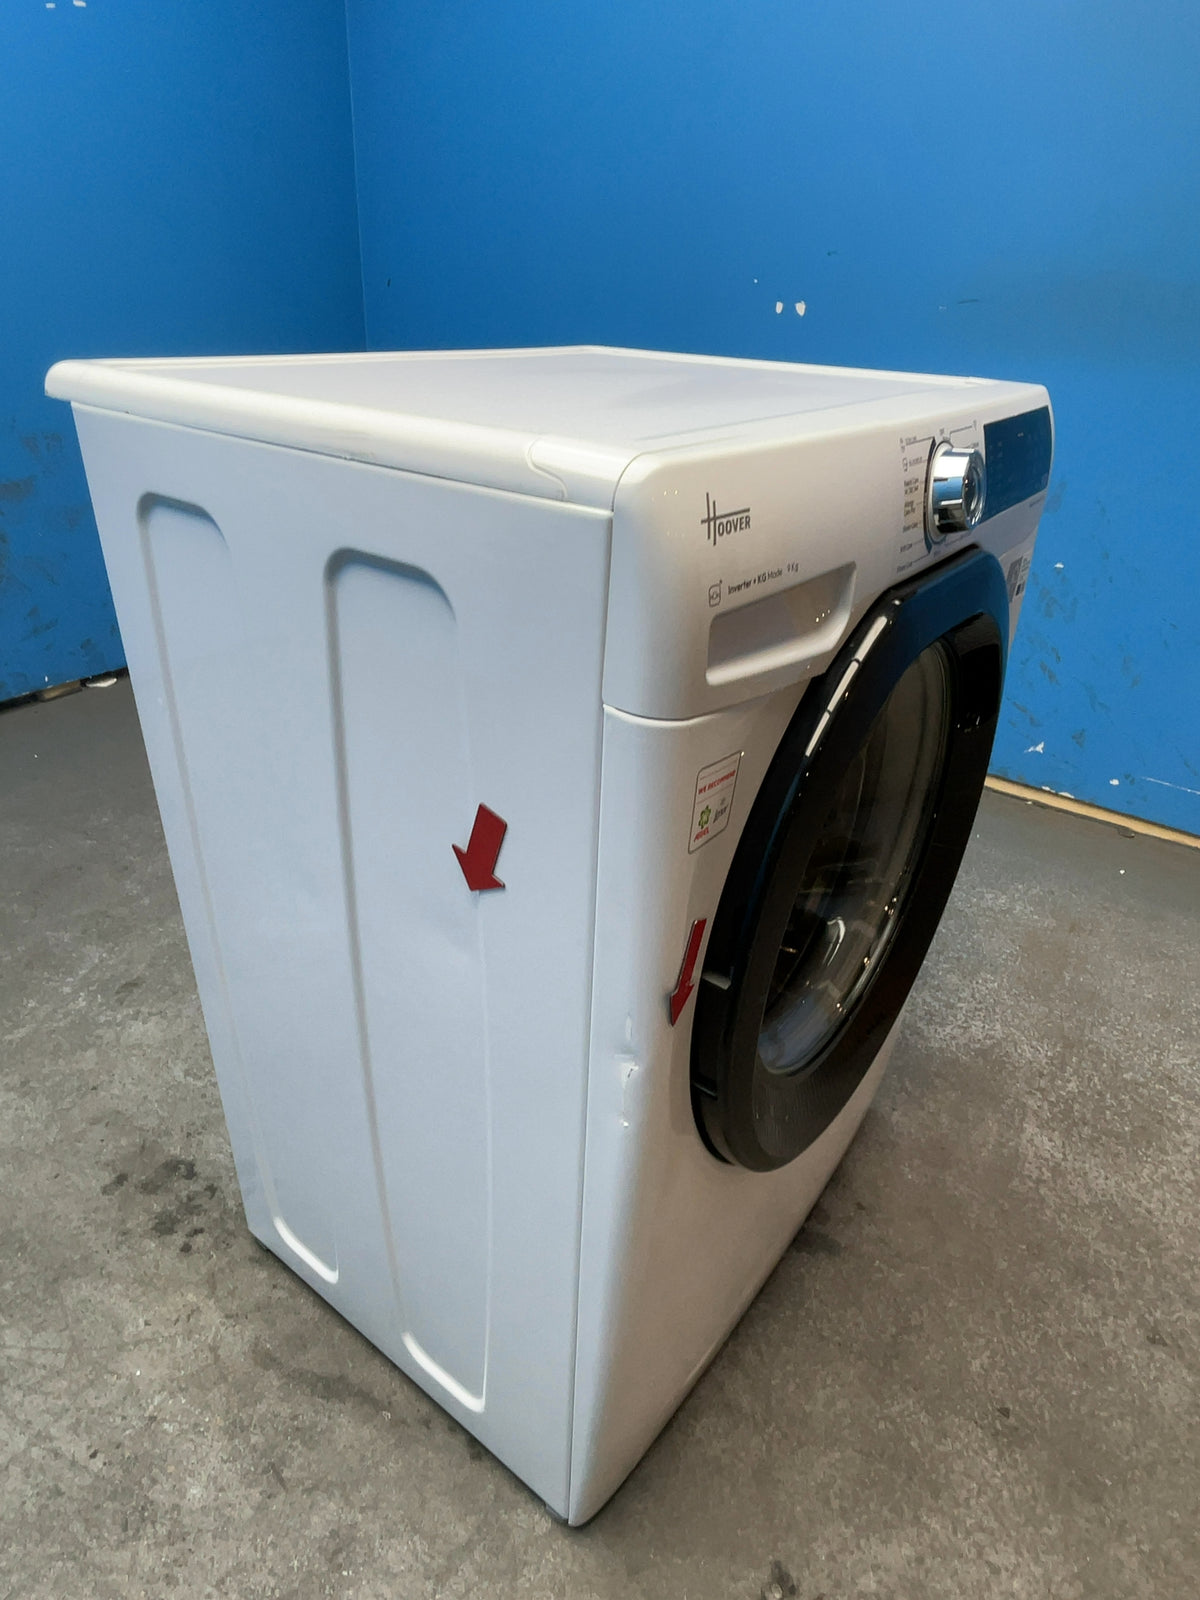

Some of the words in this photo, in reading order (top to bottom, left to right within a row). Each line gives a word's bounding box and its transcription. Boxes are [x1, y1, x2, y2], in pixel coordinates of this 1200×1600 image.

[701, 492, 751, 546] HOOVER
[728, 580, 752, 595] Inverter
[757, 573, 767, 585] KG
